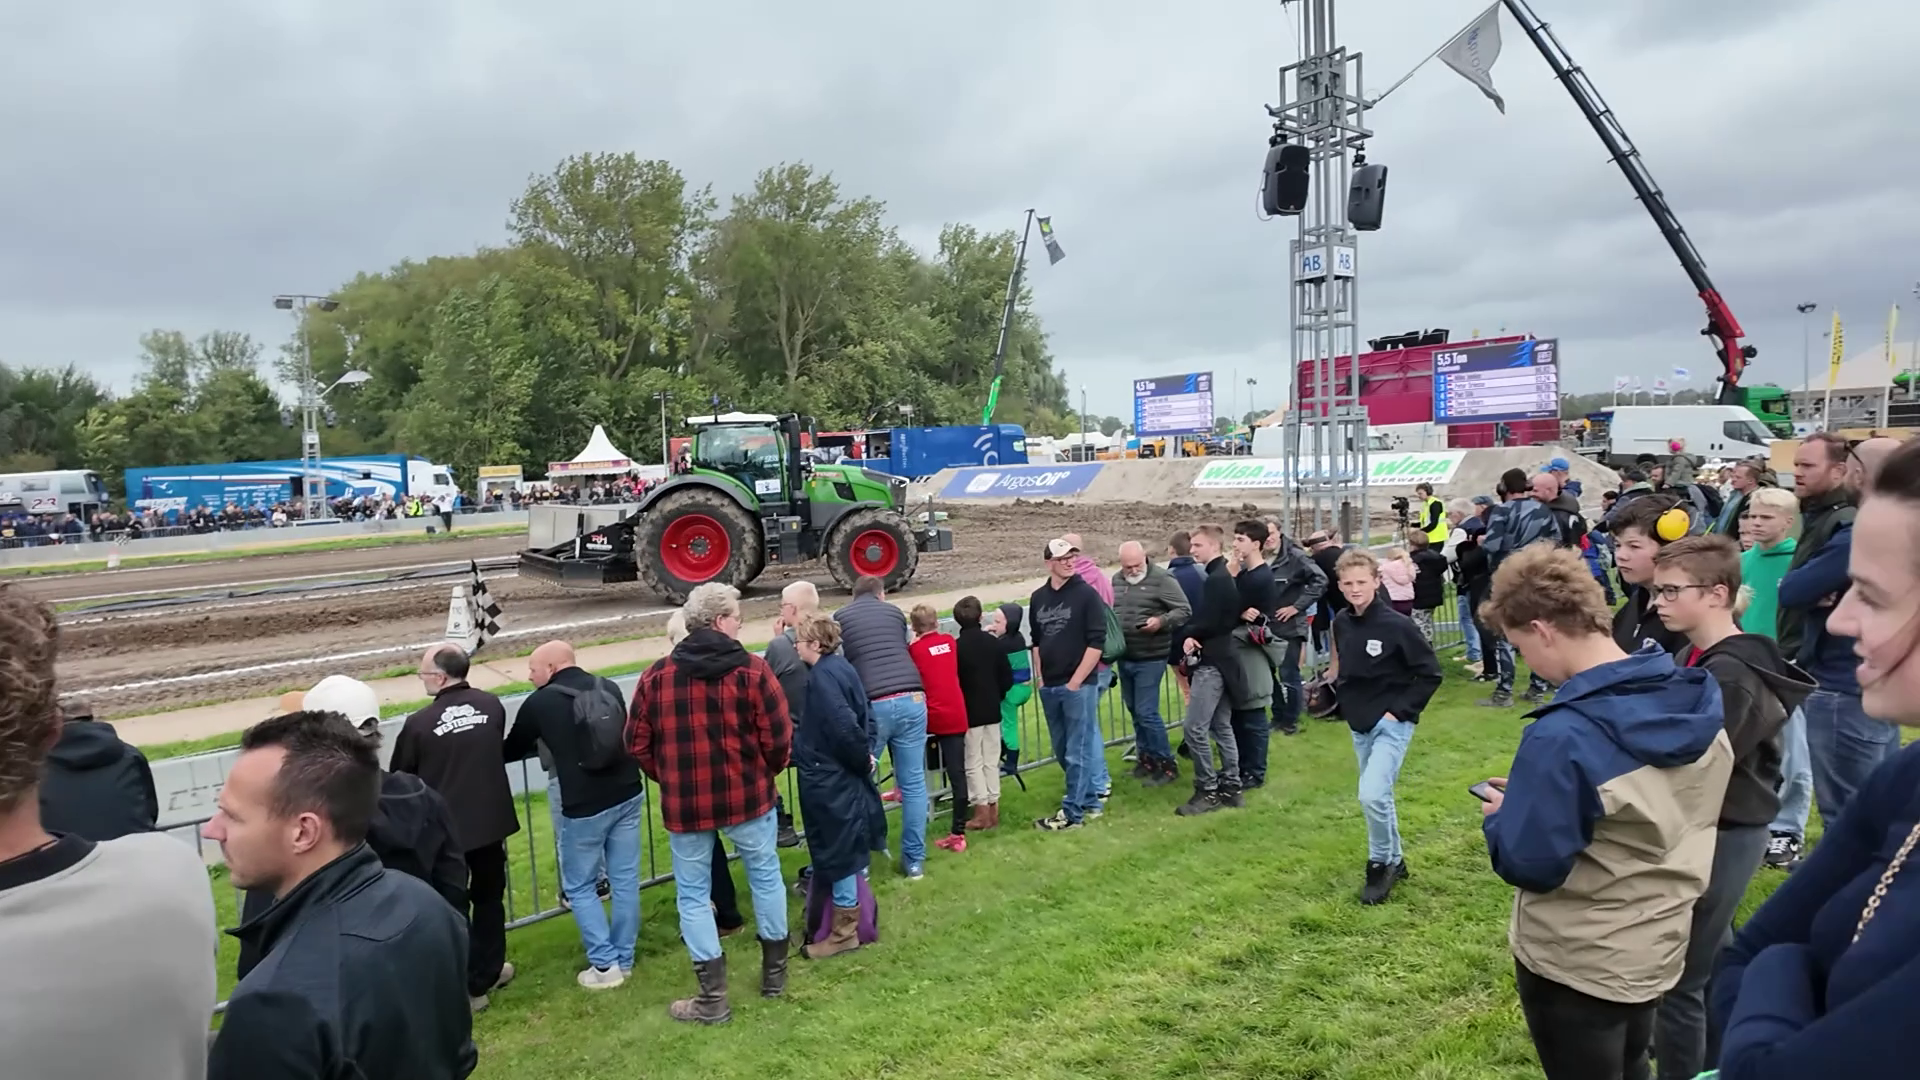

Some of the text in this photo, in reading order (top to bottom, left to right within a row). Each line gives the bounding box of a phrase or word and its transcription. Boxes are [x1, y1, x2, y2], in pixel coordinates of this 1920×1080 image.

[1303, 255, 1321, 272] AB
[1339, 254, 1351, 270] AB
[1437, 352, 1468, 366] 5,5 Ton
[1136, 381, 1145, 391] 4,5
[1204, 462, 1264, 479] WIBA
[1372, 456, 1453, 476] WIBA
